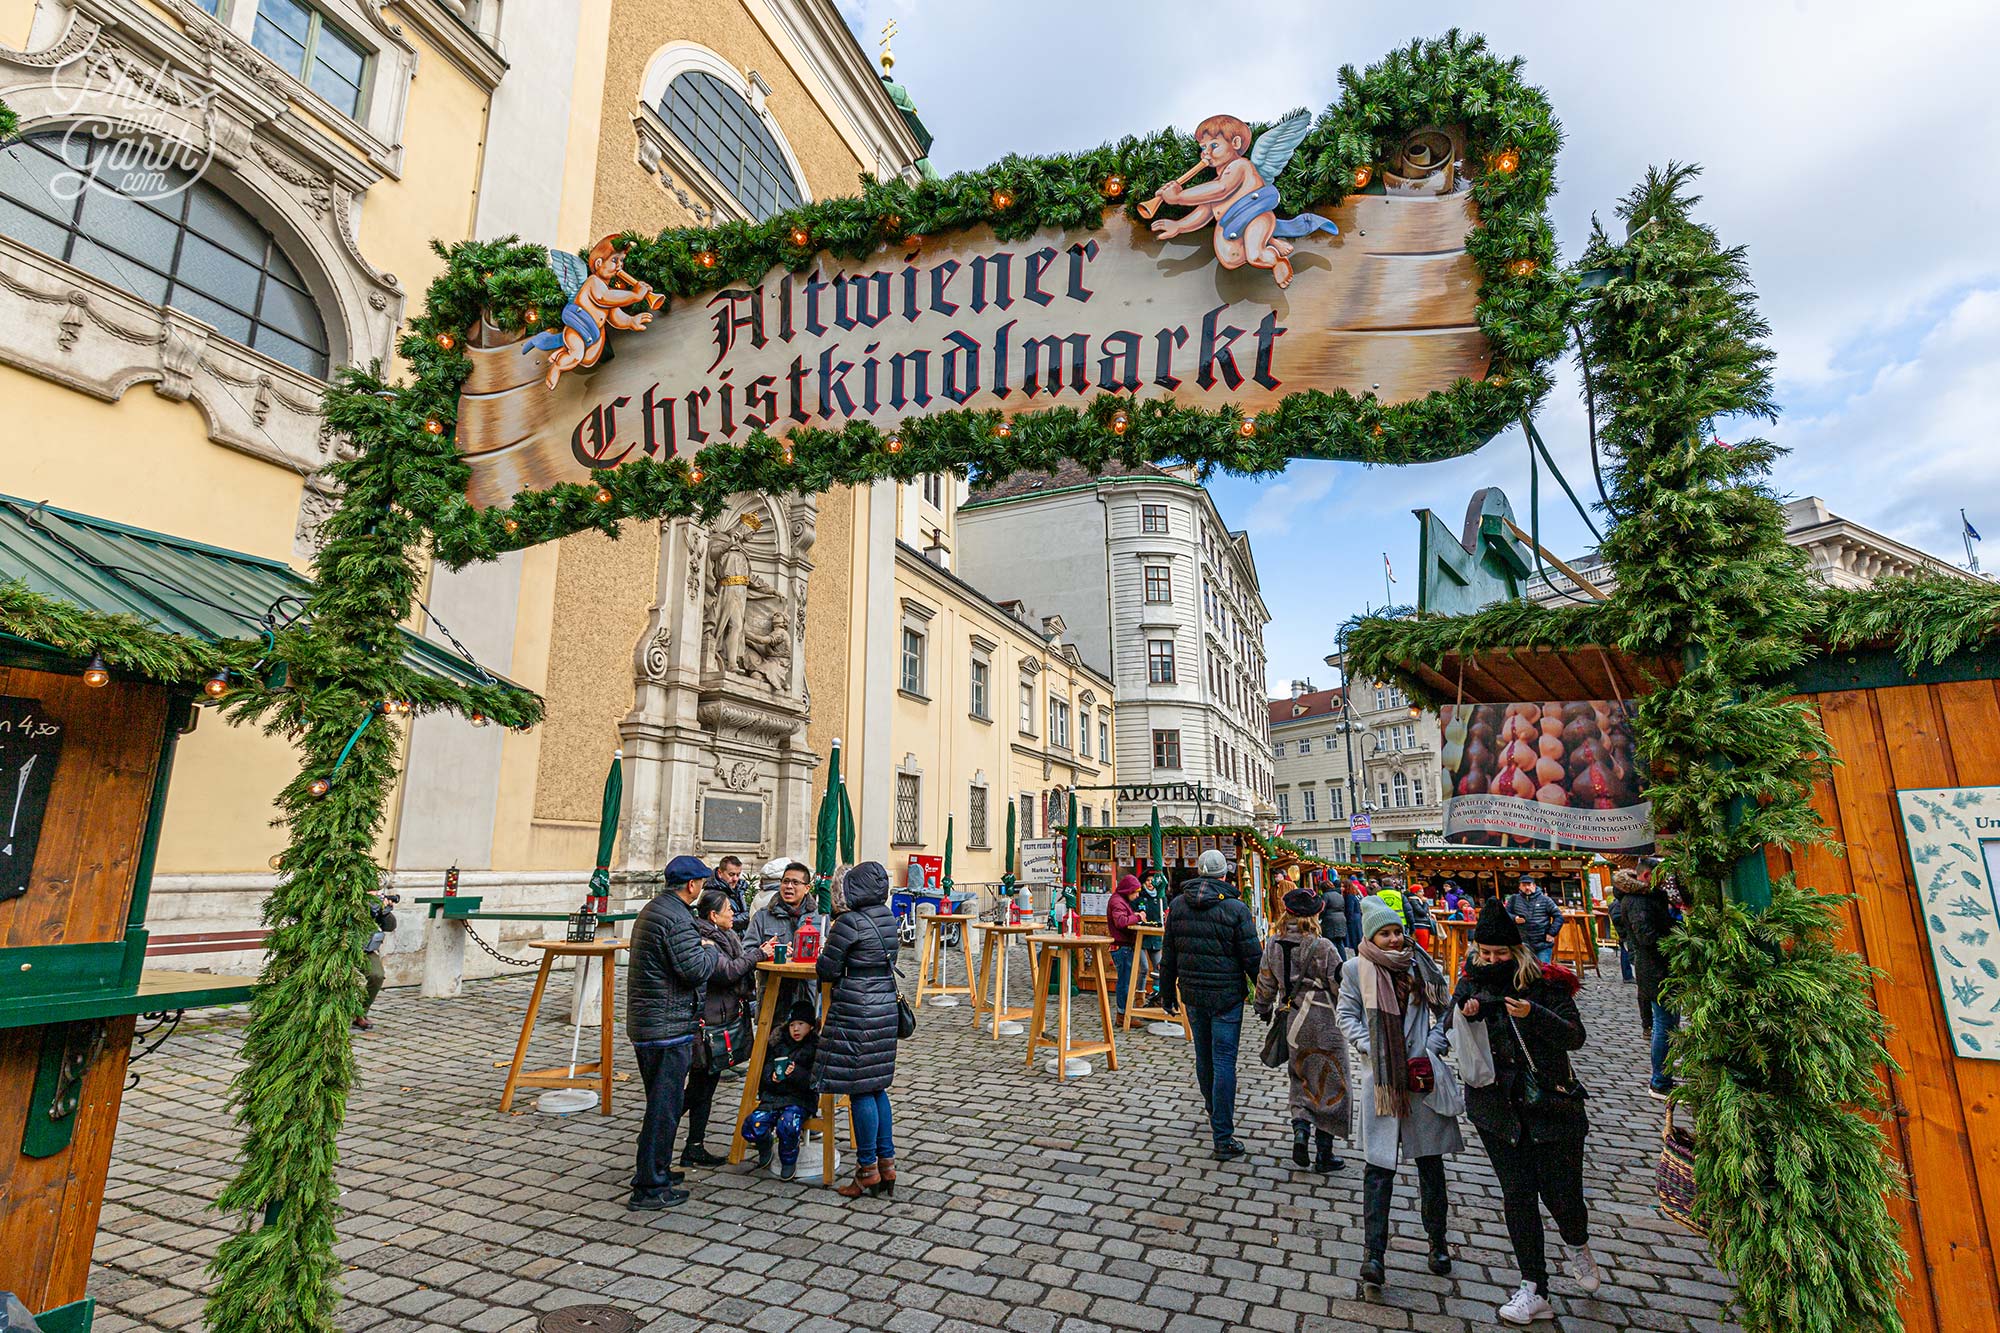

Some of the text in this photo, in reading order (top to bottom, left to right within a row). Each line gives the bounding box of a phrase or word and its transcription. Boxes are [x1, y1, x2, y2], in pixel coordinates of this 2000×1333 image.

[706, 239, 1100, 374] Altwiener
[571, 303, 1289, 470] Christkindlmarkt
[1118, 786, 1214, 801] APOTHEKE
[1507, 820, 1518, 828] SIE
[1519, 823, 1538, 832] BITTE
